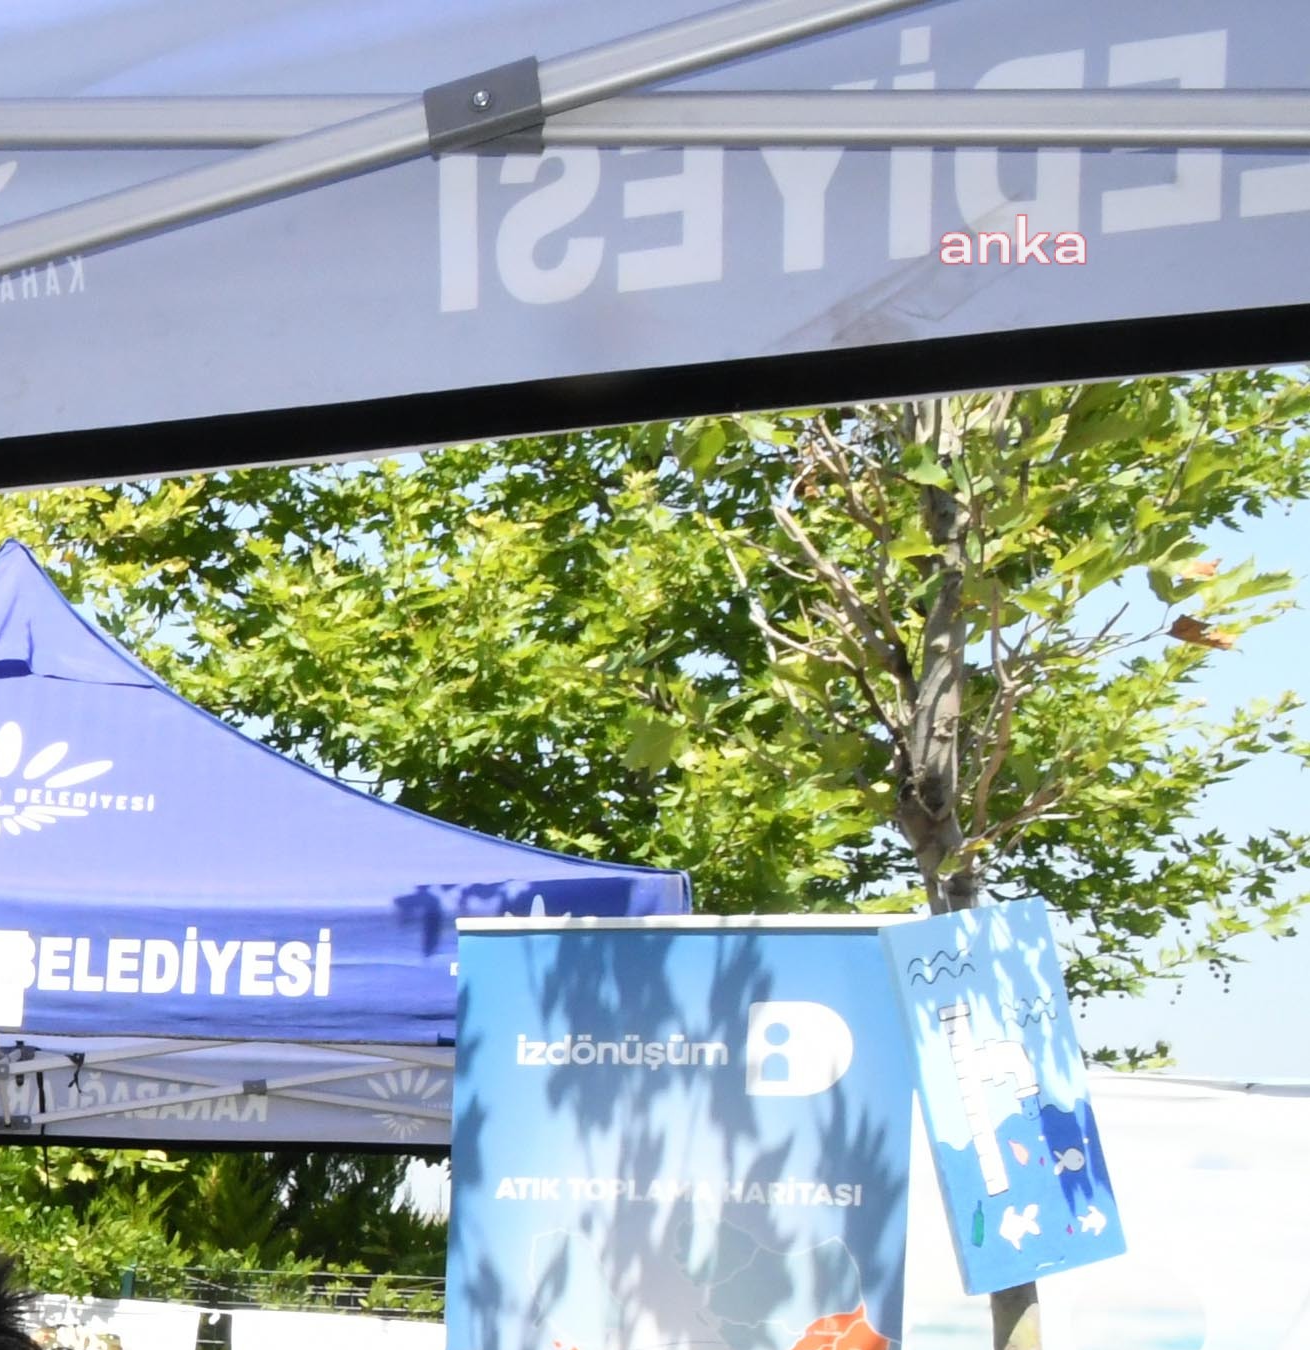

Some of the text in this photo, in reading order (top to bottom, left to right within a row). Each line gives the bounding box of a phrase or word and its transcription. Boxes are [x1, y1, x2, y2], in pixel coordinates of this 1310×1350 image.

[516, 1034, 729, 1072] izdönüşüm
[495, 1176, 863, 1207] ATIK TOPLAMA HARİTASI
